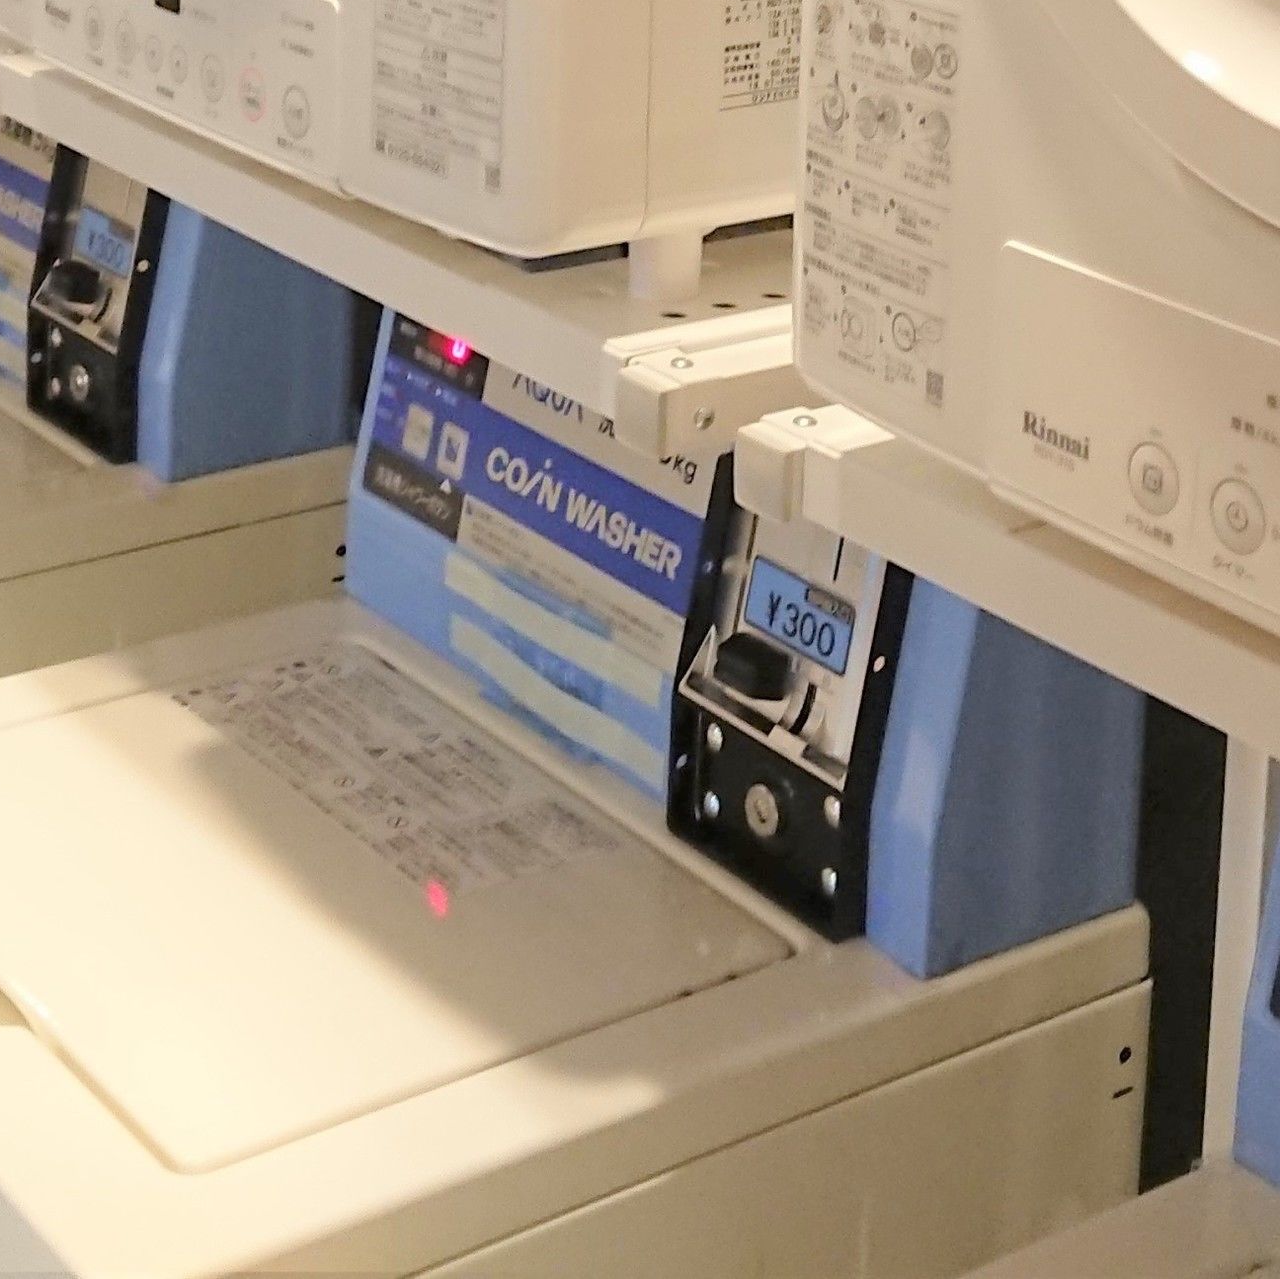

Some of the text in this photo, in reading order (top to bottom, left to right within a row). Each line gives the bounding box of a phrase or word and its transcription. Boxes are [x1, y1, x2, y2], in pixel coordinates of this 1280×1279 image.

[1022, 410, 1090, 461] Rinnai
[659, 454, 698, 485] kg
[567, 488, 683, 580] WASHER
[768, 591, 836, 657] ¥300
